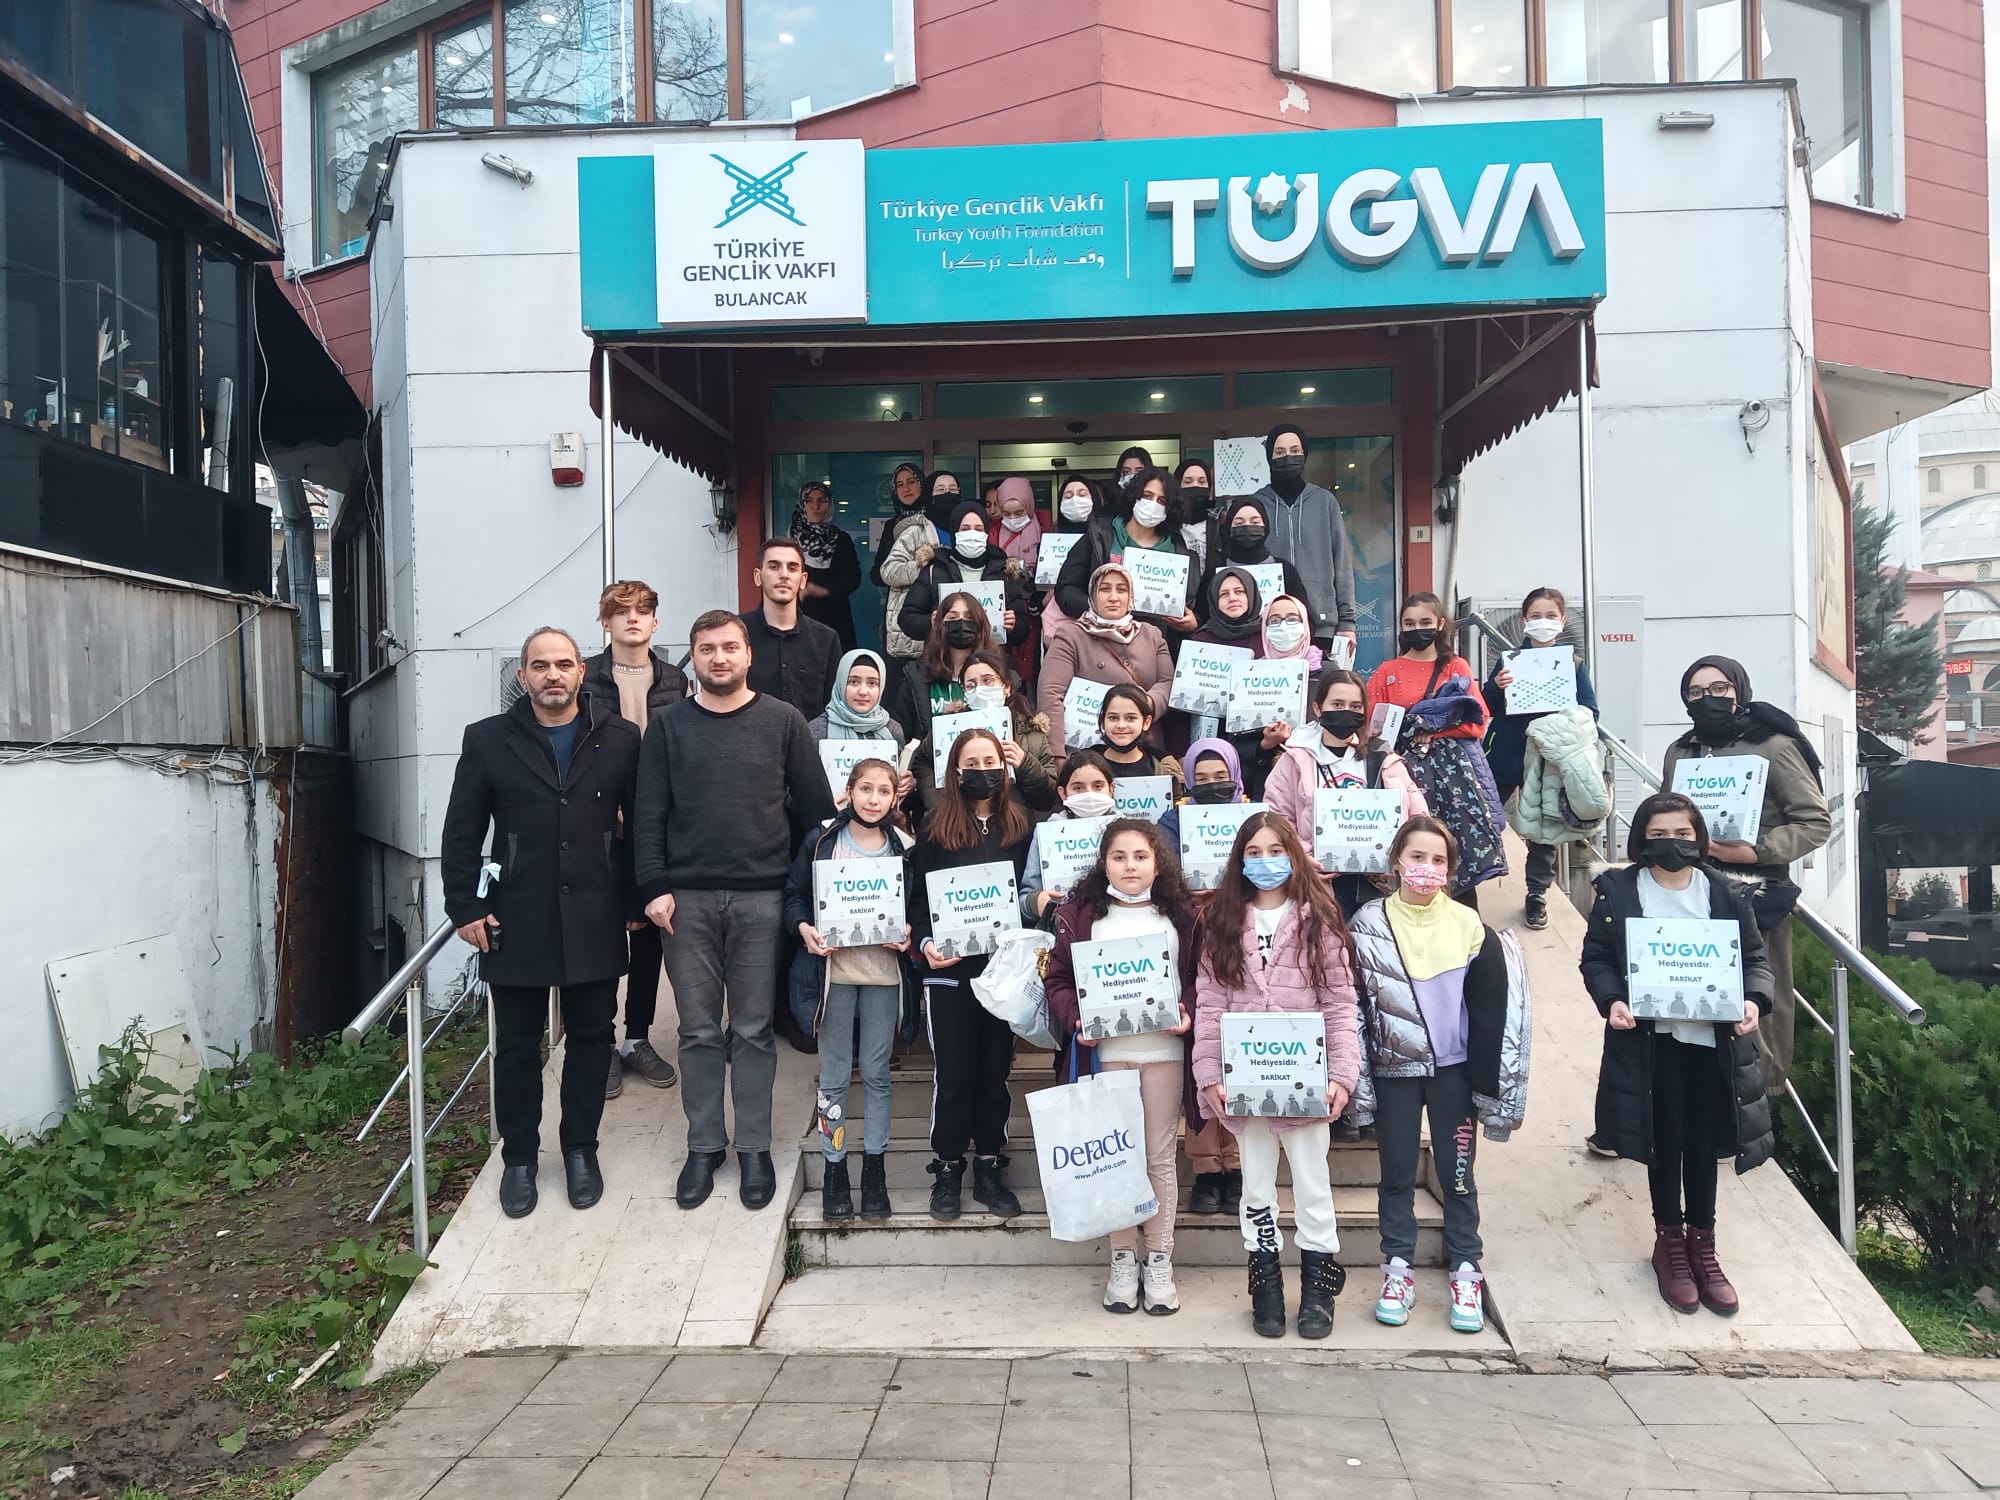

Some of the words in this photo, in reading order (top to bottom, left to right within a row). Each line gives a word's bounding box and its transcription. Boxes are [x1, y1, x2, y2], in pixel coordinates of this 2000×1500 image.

[879, 198, 960, 222] Türkiye
[965, 195, 1045, 216] Gençlik
[1048, 191, 1104, 213] Vakfı
[1146, 162, 1586, 276] TÜGVA
[913, 226, 964, 245] Turkey
[966, 223, 1012, 241] Youth
[1015, 221, 1104, 239] Foundation
[713, 238, 805, 260] TÜRKİYE
[683, 260, 772, 282] GENÇLİK
[775, 262, 836, 279] VAKFI
[715, 291, 808, 307] BULANCAK
[1601, 634, 1637, 643] VESTEL
[1242, 677, 1290, 688] TÜGVA
[1076, 695, 1103, 709] TÜG
[1687, 776, 1737, 790] TÜGVA
[1115, 797, 1158, 810] ÜGVA
[1331, 808, 1387, 821] TÜGVA
[1196, 824, 1238, 837] TÜG
[1054, 834, 1101, 852] TÜGV
[833, 878, 888, 893] TÜGVA
[944, 885, 1002, 904] TÜGVA
[1647, 942, 1721, 958] TÜGVA
[1091, 958, 1156, 978] TÜGVA
[1658, 959, 1713, 969] Hediyesidir.
[1102, 975, 1149, 988] Hediyesidir.
[1240, 1041, 1307, 1056] TÜGVA
[1250, 1058, 1300, 1068] Hediyesidir.
